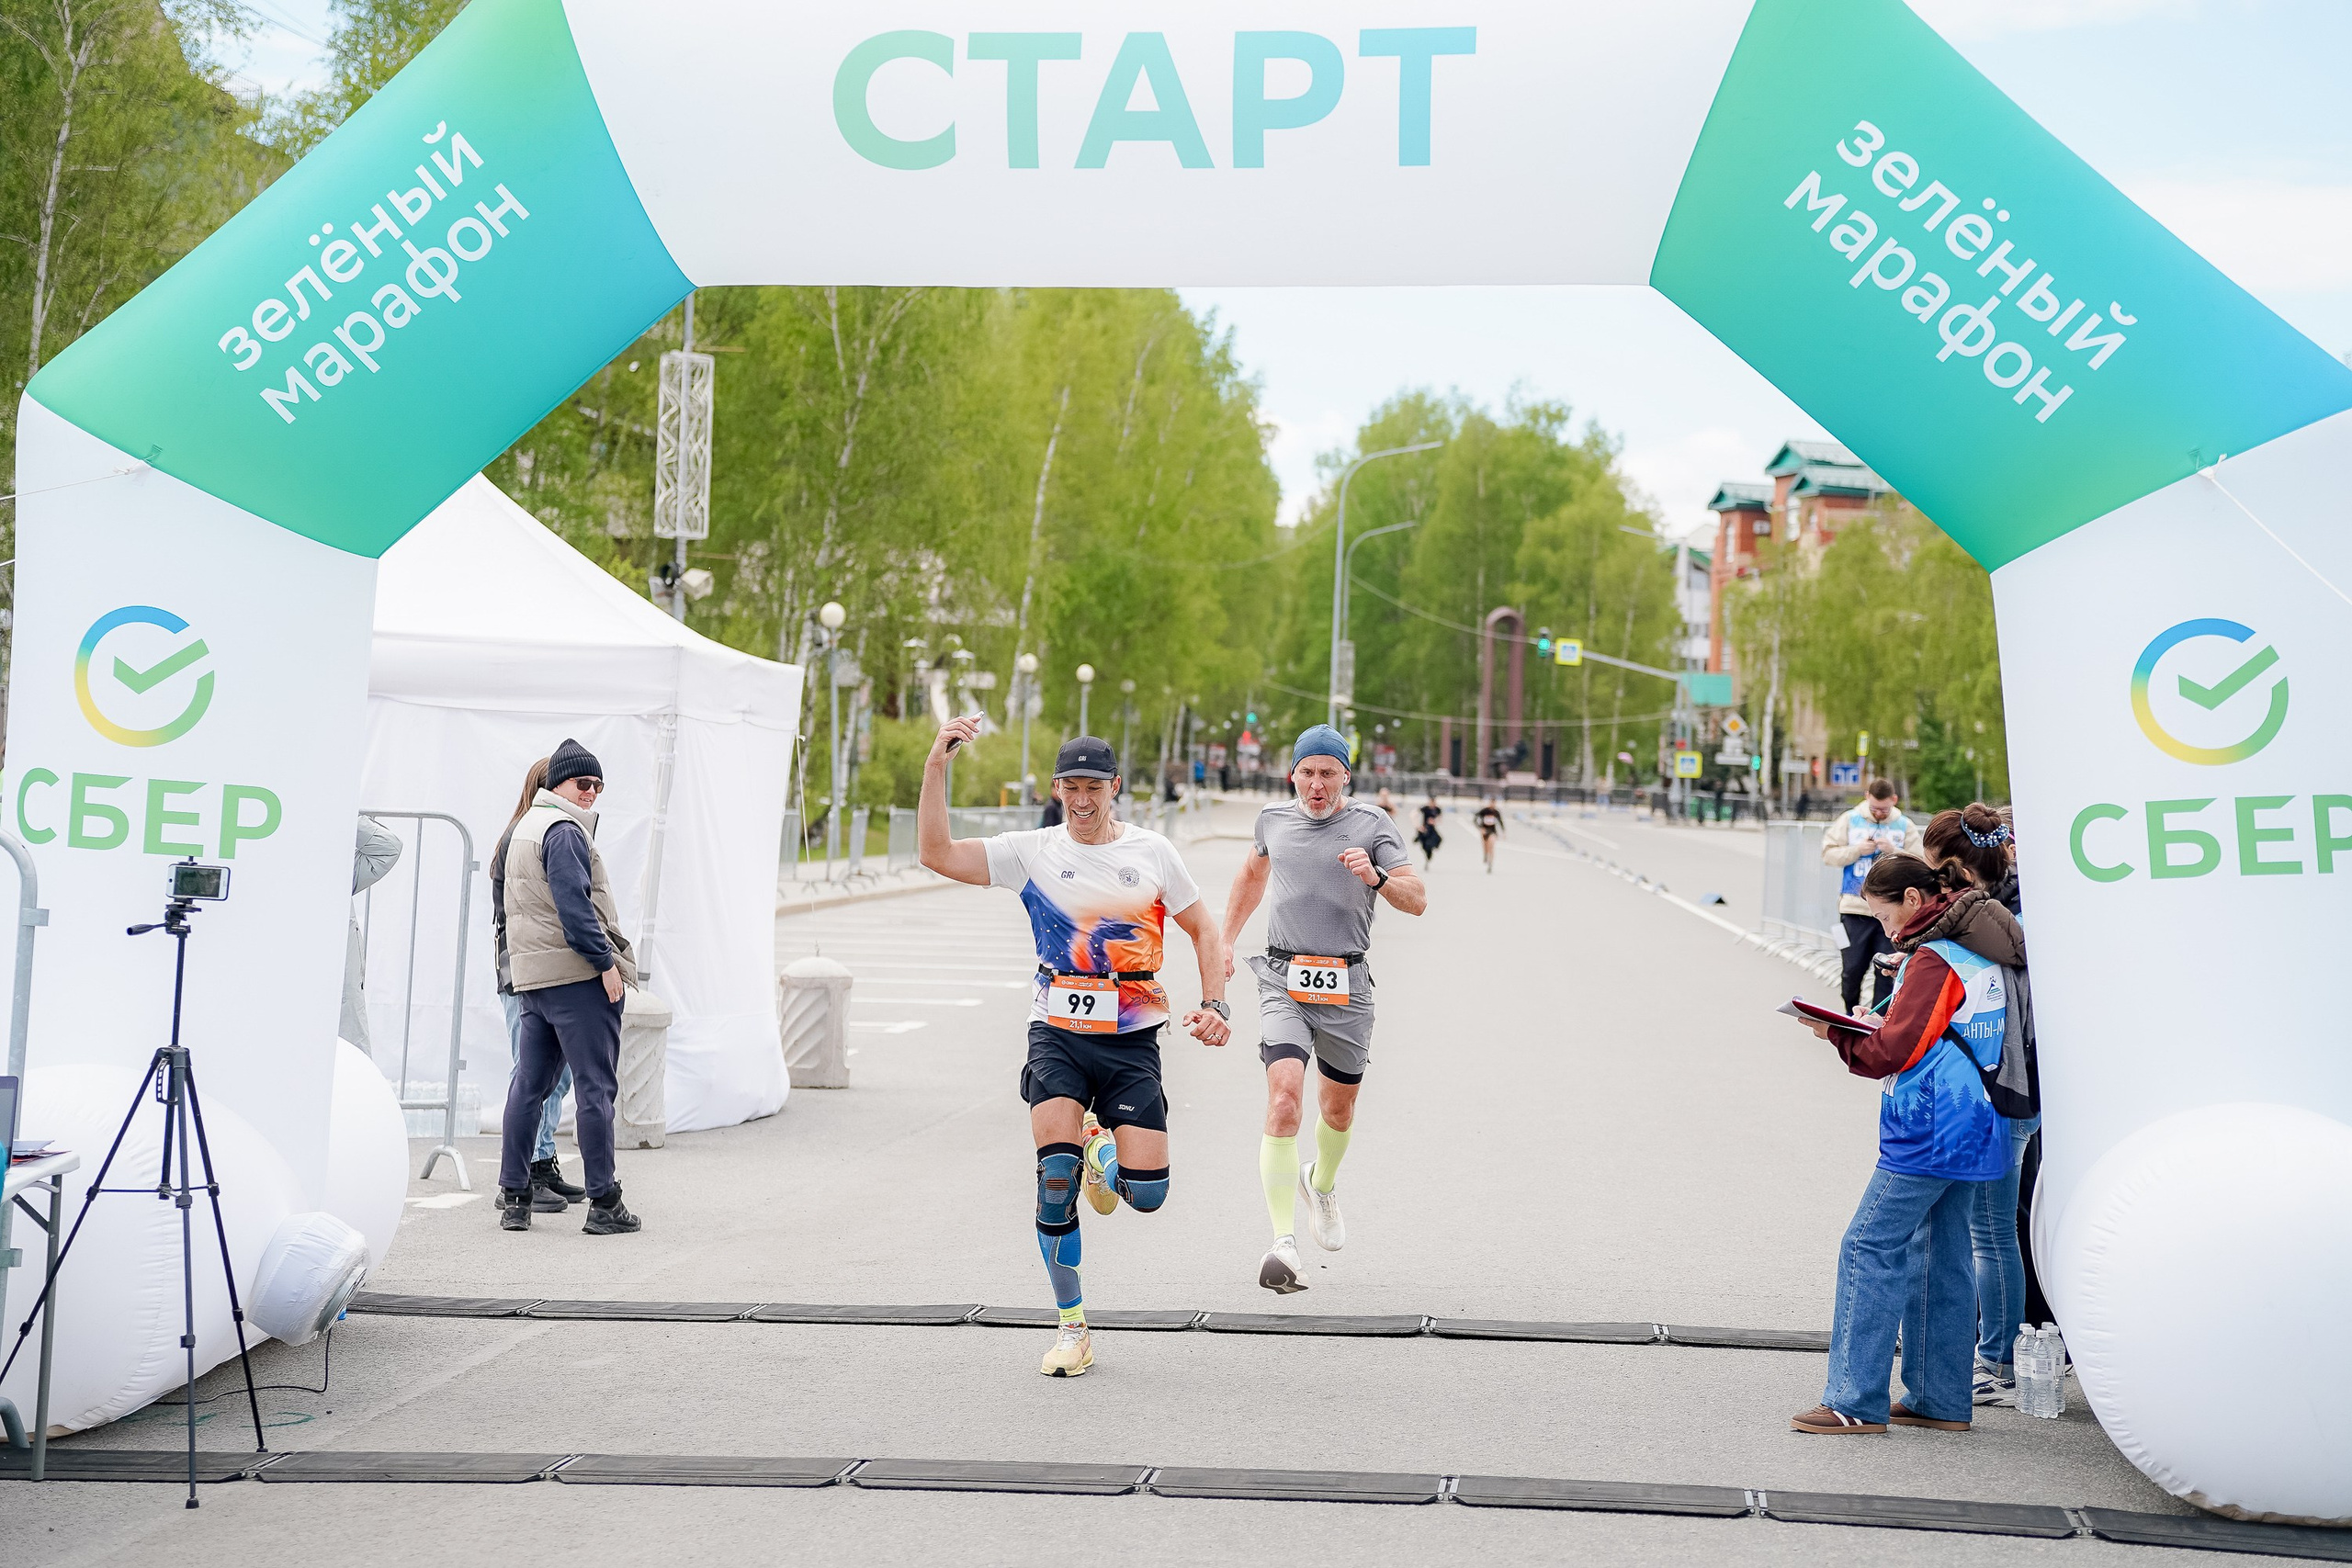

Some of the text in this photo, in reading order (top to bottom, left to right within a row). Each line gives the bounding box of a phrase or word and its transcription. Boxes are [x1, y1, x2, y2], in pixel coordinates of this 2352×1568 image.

[832, 27, 1477, 171] СТАРТ
[218, 119, 484, 371] зелёный
[259, 183, 530, 424] марафон
[1783, 170, 2075, 423] марафон
[1836, 119, 2139, 371] зелёный
[17, 767, 283, 861] СБЕР
[2069, 794, 2352, 883] СБЕР
[1068, 993, 1096, 1015] 99
[1299, 969, 1338, 990] 363
[1962, 1017, 2005, 1040] АНТЫ-М
